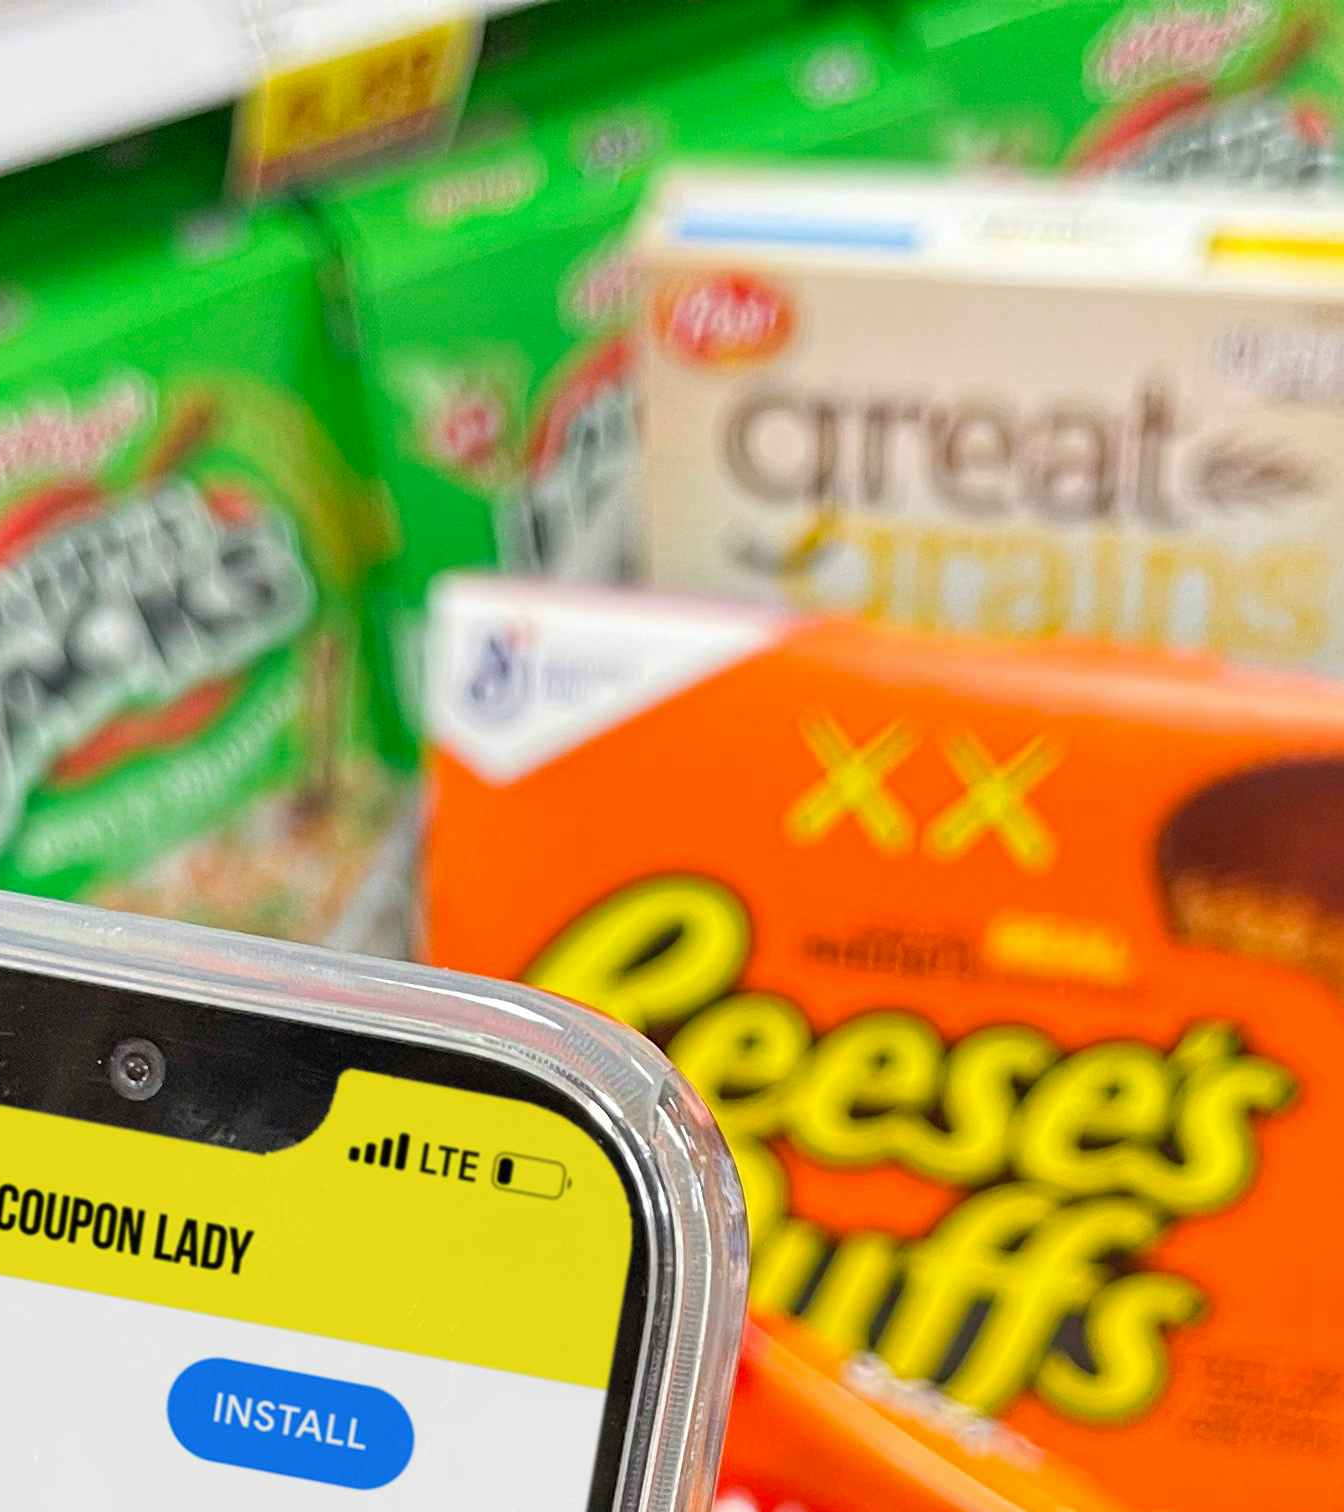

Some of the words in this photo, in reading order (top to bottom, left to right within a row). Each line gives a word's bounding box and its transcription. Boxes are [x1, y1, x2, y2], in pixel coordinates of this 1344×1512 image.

[718, 375, 1191, 575] great
[524, 872, 1301, 1218] Reese's
[419, 1143, 481, 1183] LTE
[152, 1212, 255, 1276] LADY
[212, 1392, 368, 1452] INSTALL
